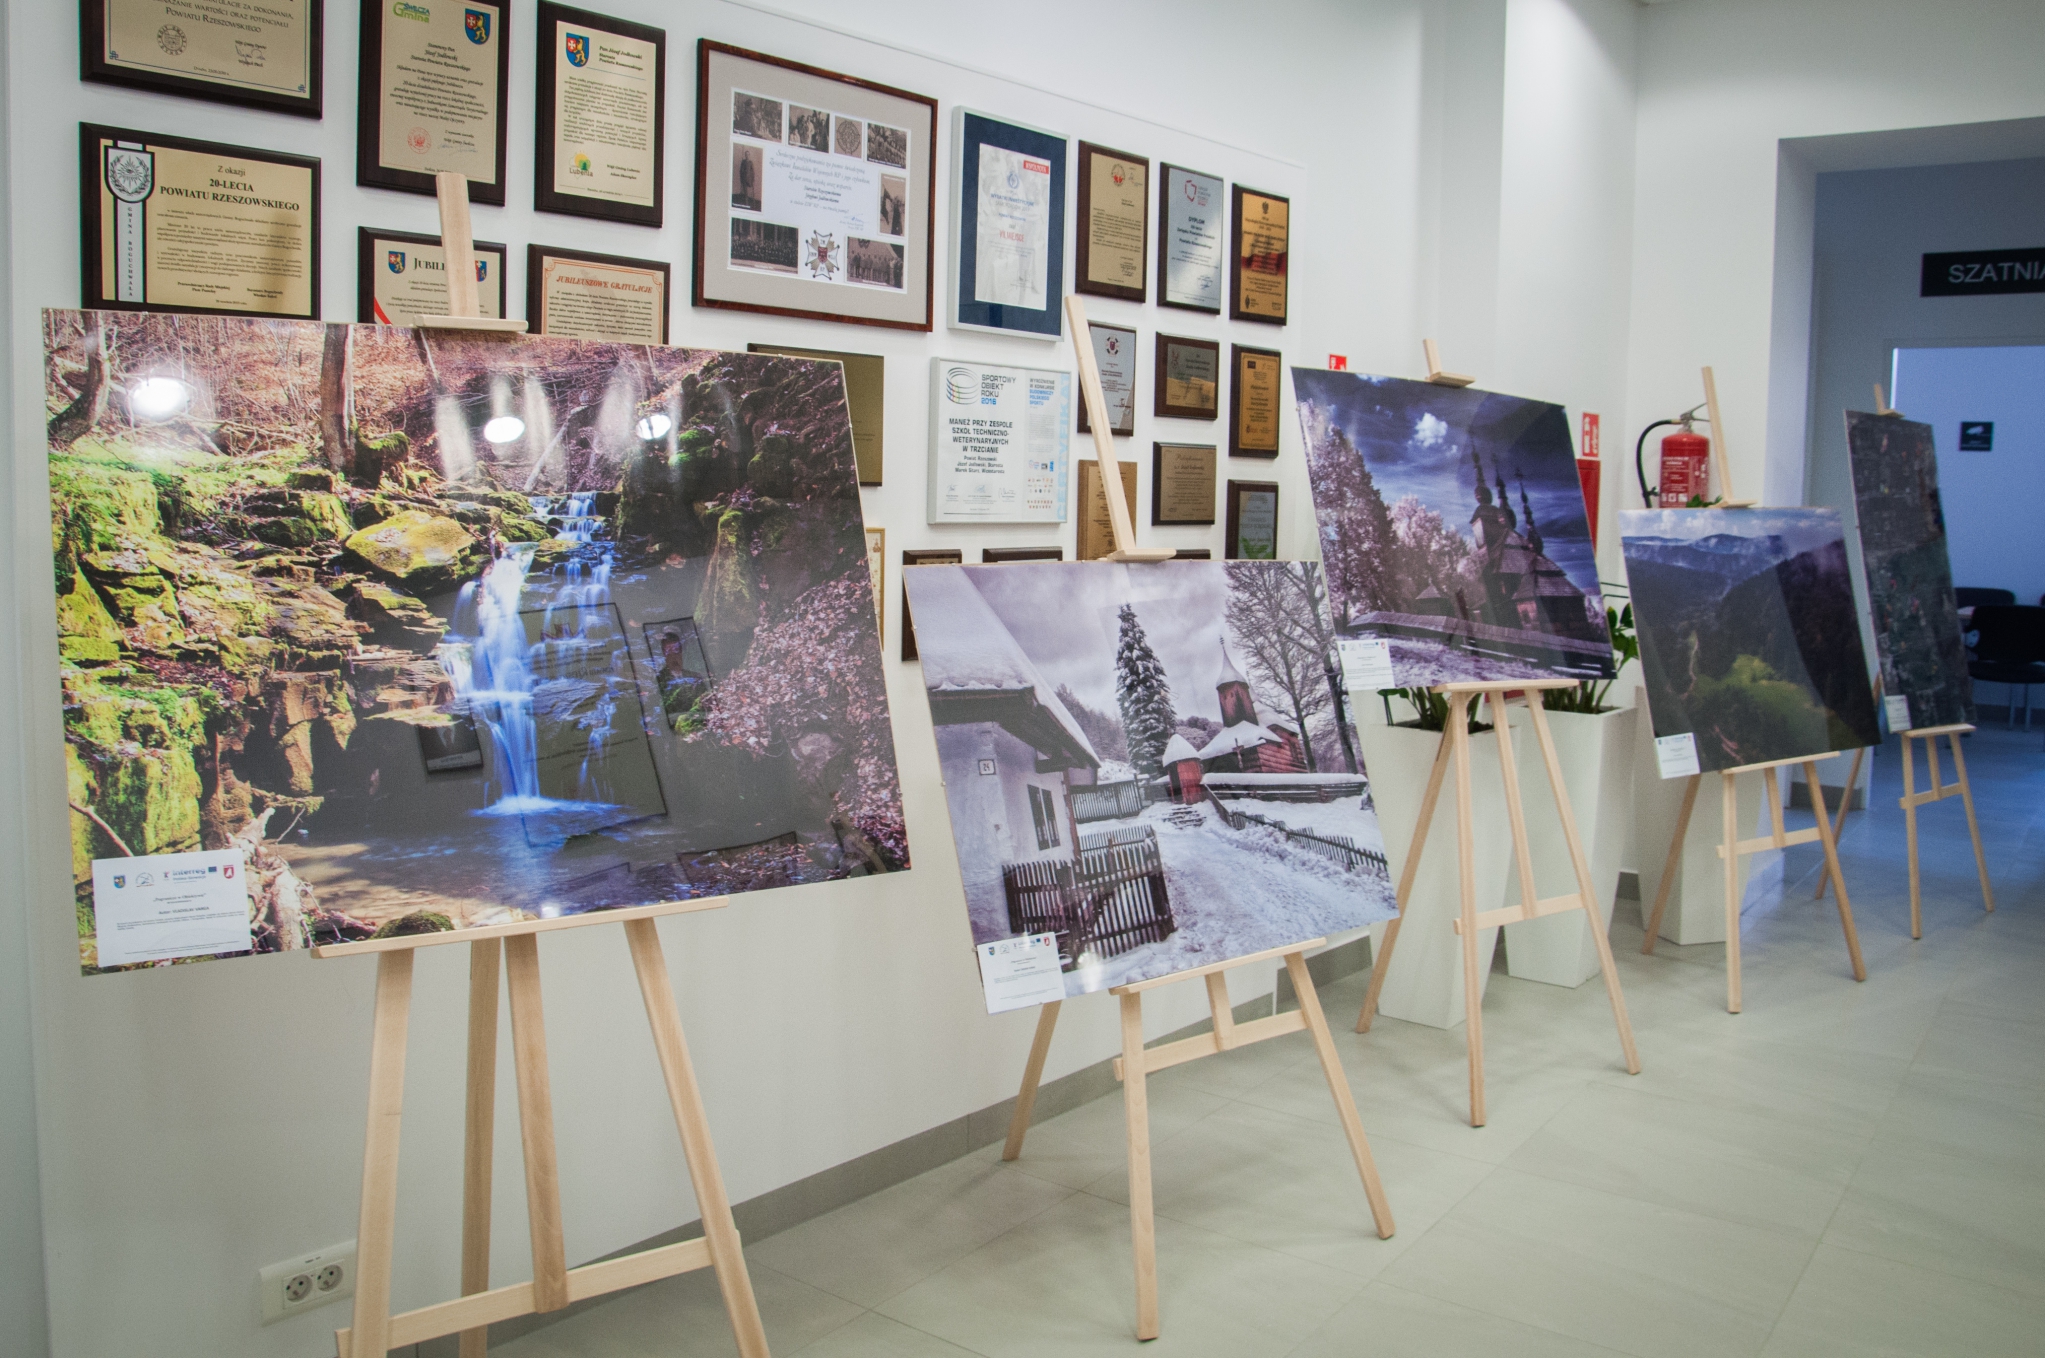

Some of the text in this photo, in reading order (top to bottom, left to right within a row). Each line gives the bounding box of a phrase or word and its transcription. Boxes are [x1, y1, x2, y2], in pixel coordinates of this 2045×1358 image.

[393, 2, 430, 23] Gmina
[225, 167, 246, 177] okazji
[569, 167, 594, 177] Lubenia
[209, 178, 254, 192] 20-LECIA
[160, 186, 300, 211] POWIATU RZESZOWSKIEGO
[556, 275, 653, 294] JUBILEUSZOWE GRATULACJE
[981, 374, 1017, 384] SPORTOWY
[981, 382, 1004, 390] OBIEKT
[981, 390, 999, 398] ROKU
[949, 417, 971, 426] MANEŻ
[952, 427, 1009, 437] SZKÓŁ TECHNICZNO-
[952, 436, 1009, 445] WETERYNARYJNYCH
